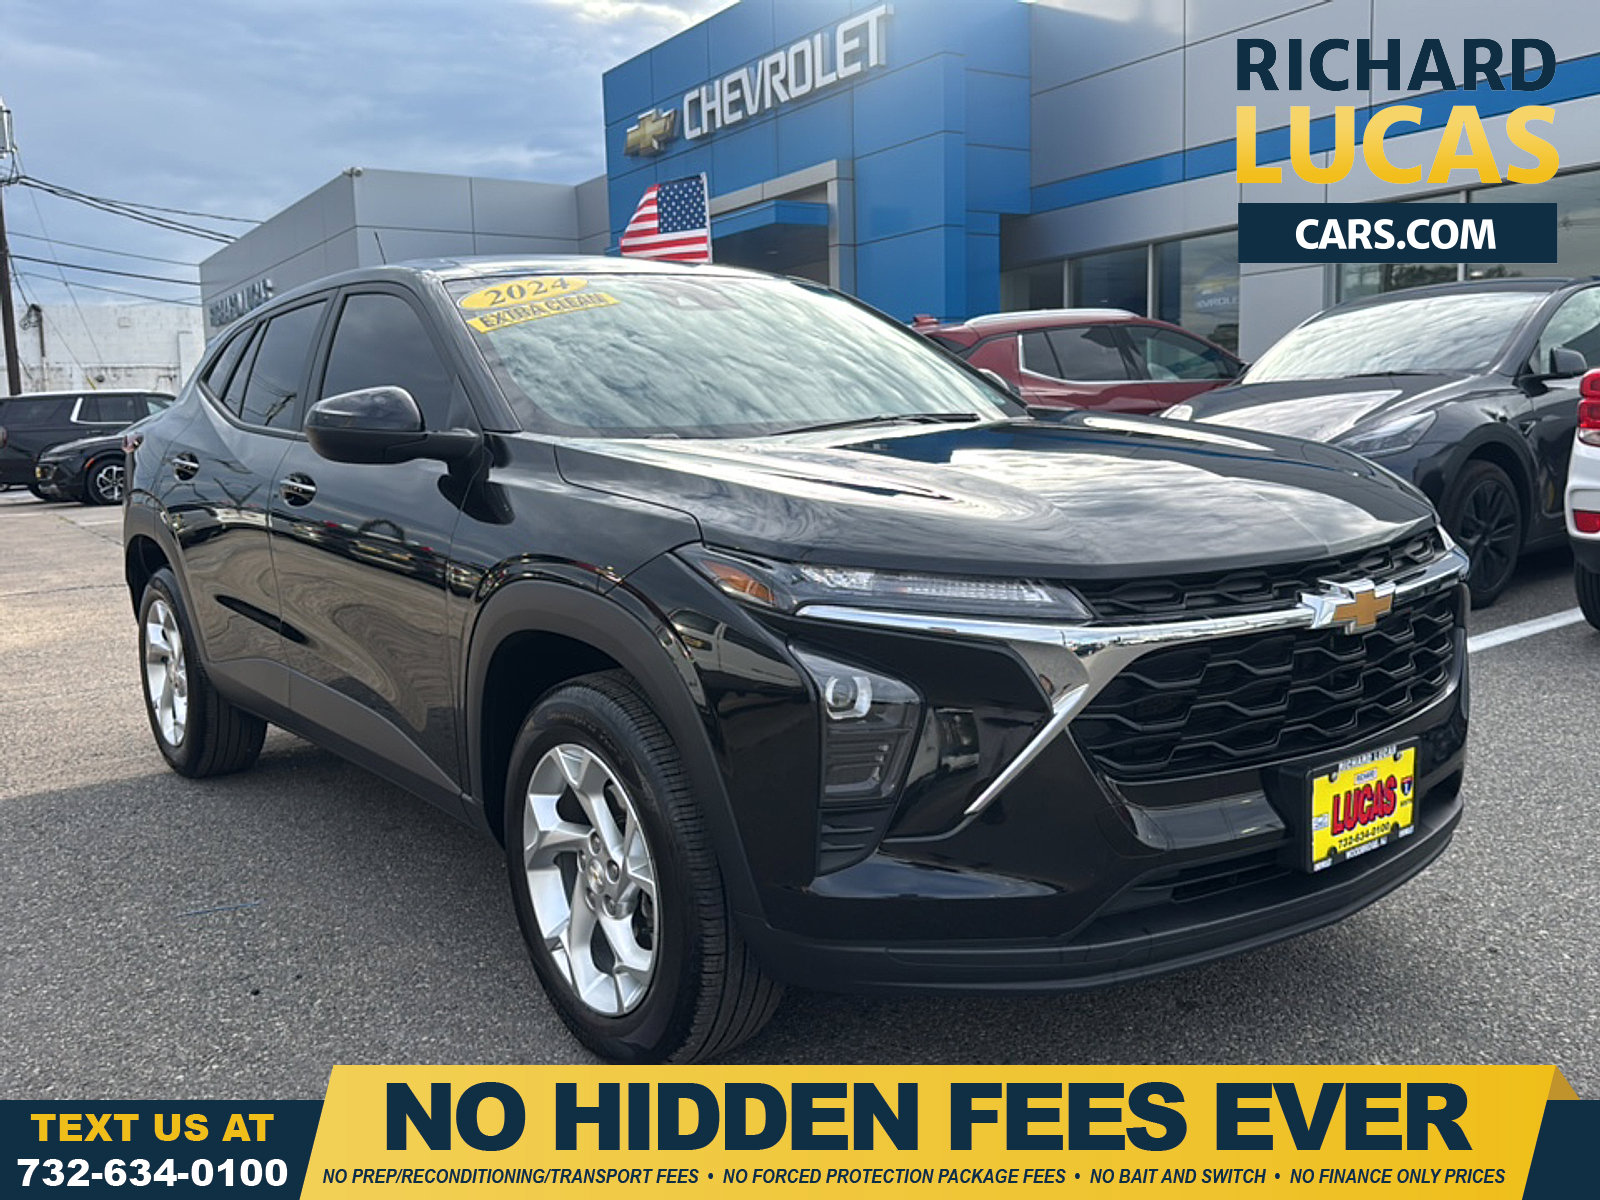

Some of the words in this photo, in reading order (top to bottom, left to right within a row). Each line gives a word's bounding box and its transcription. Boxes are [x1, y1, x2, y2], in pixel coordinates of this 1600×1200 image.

[682, 4, 893, 141] CHEVROLET
[479, 302, 545, 328] EXTRA
[546, 292, 609, 313] CLEAN
[484, 276, 571, 306] 2024
[1331, 774, 1398, 836] LUCAS
